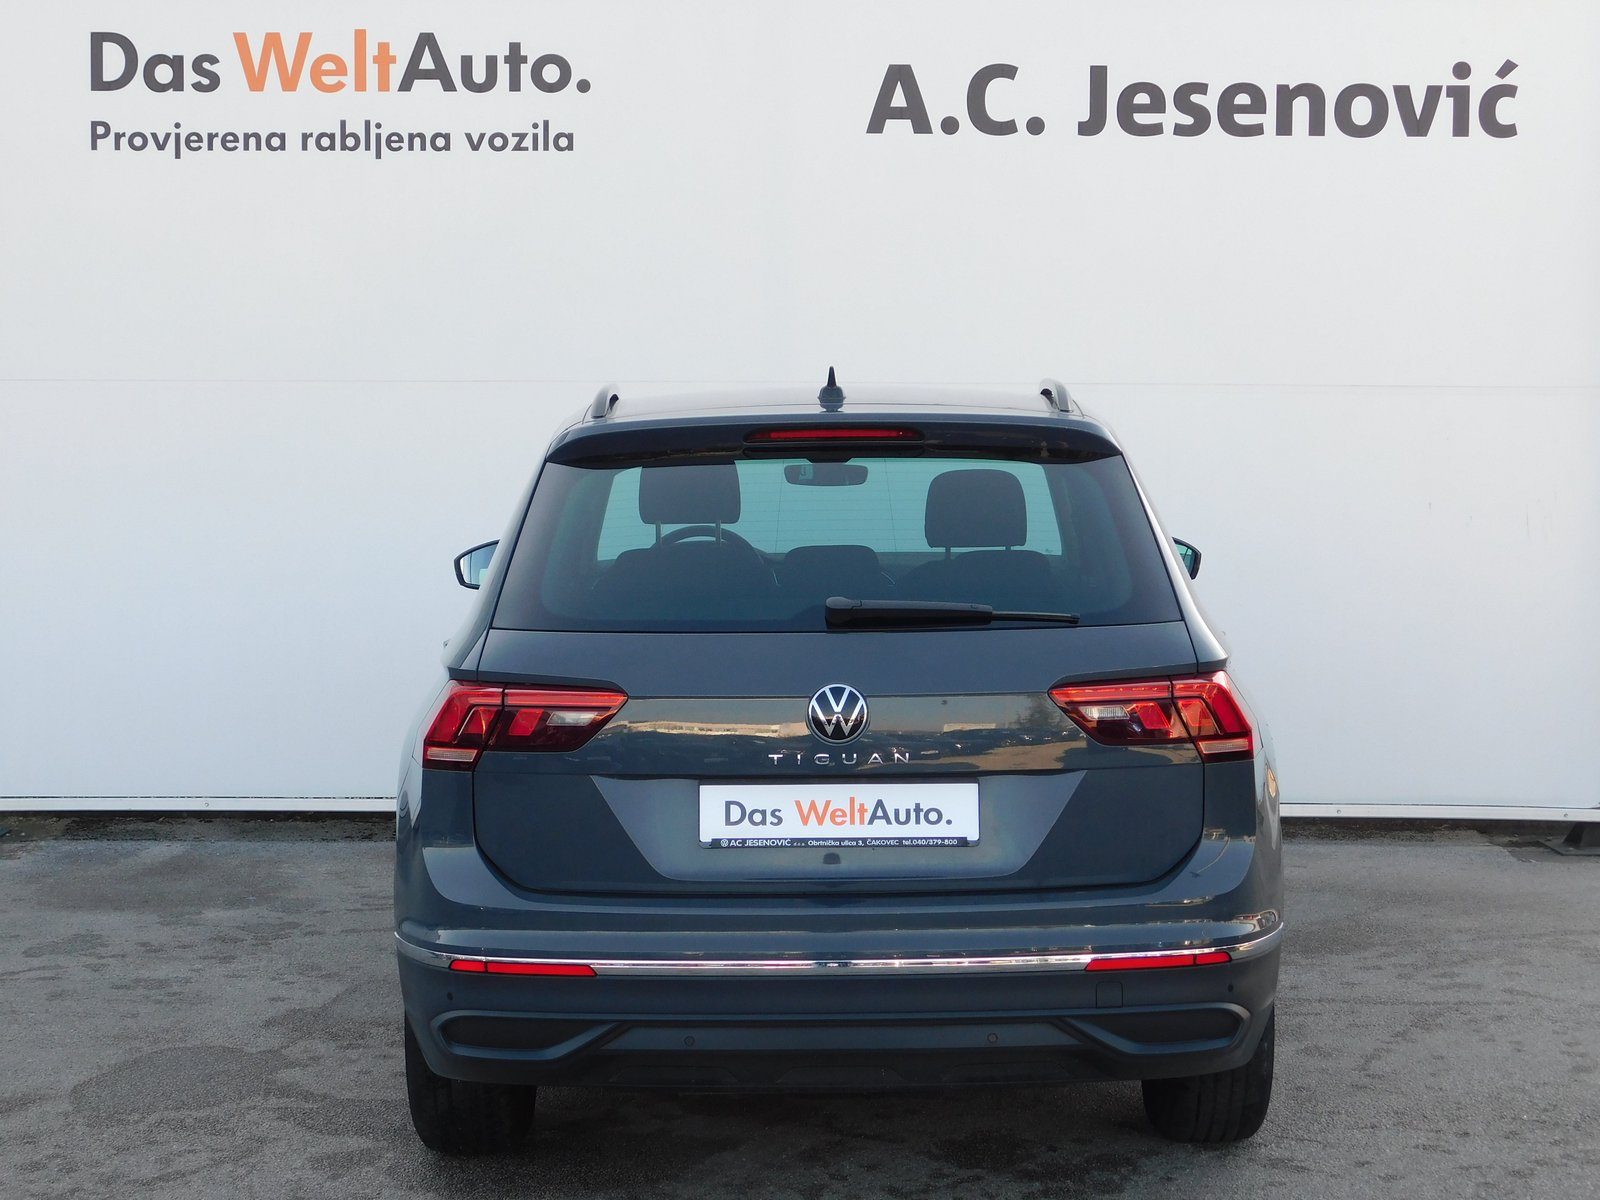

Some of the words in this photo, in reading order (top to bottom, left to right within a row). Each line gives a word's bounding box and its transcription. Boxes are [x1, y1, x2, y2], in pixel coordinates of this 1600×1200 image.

[91, 32, 220, 92] Das
[234, 29, 591, 93] WeltAuto.
[866, 64, 1045, 136] A.C.
[1078, 60, 1519, 138] Jesenović
[91, 121, 286, 159] Provjerena
[301, 120, 451, 159] rabljena
[465, 120, 574, 152] vozila
[768, 753, 910, 766] TIGUAN
[725, 801, 783, 826] Das
[794, 797, 953, 826] WeltAuto.
[729, 839, 743, 847] AC
[744, 838, 792, 847] JESENOVIĆ
[841, 839, 857, 847] ulica
[866, 838, 900, 847] ČAKOVEC
